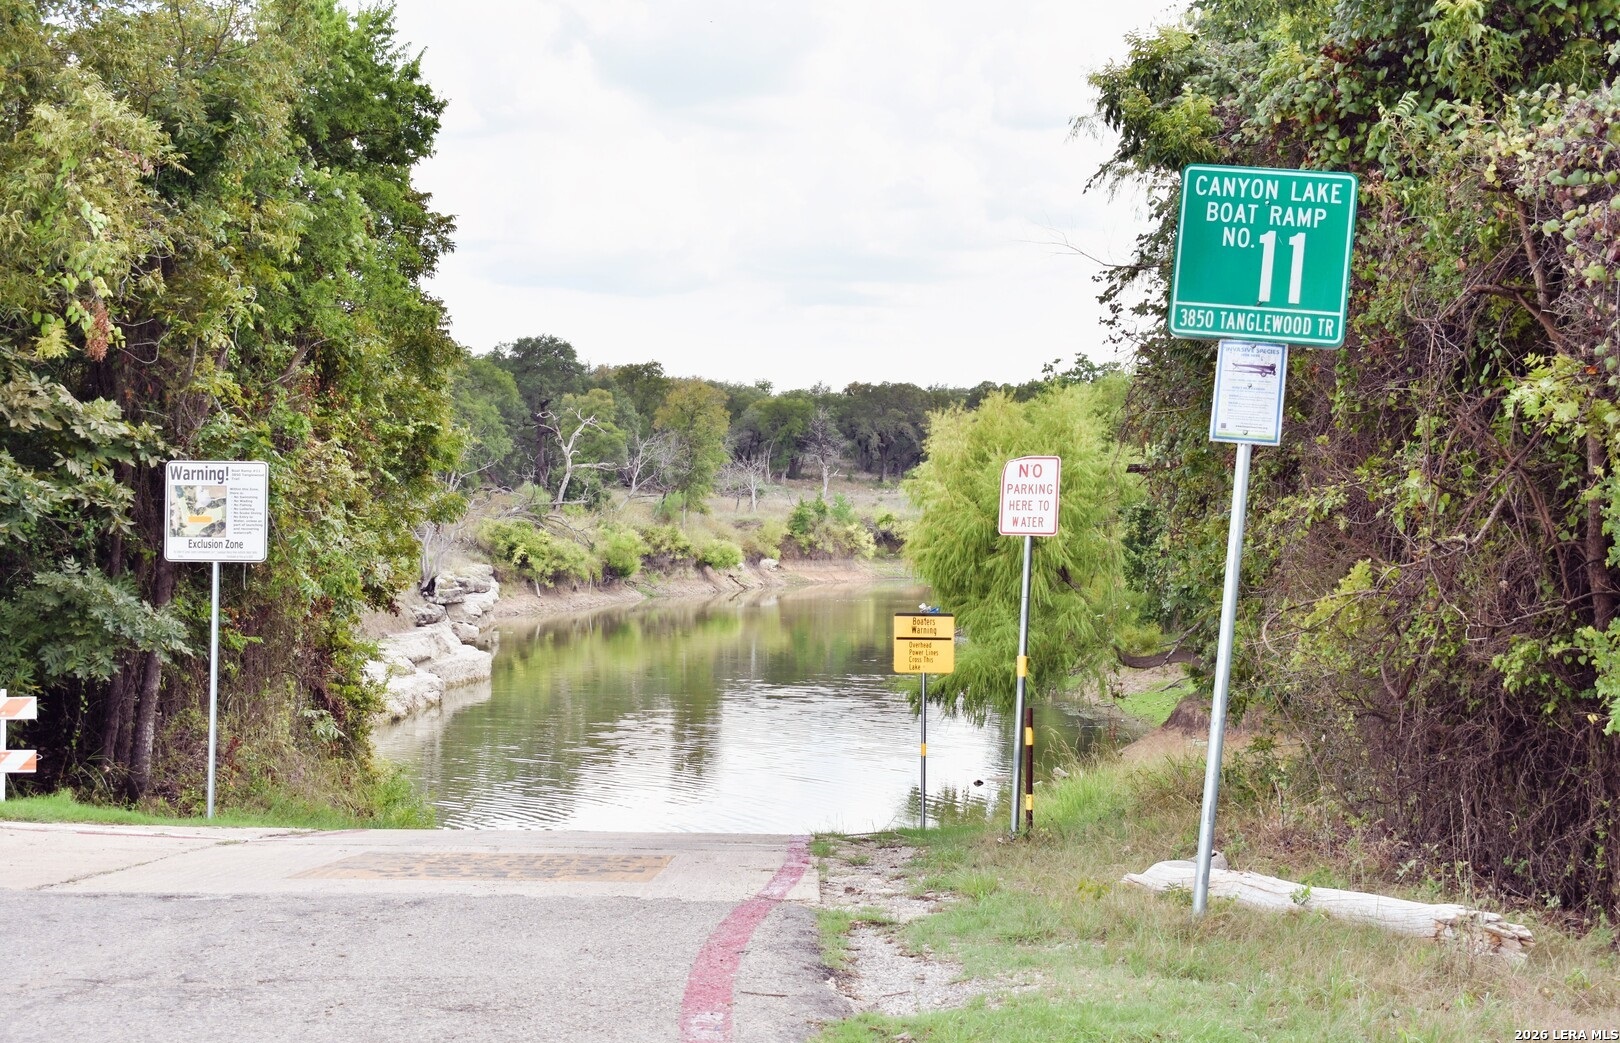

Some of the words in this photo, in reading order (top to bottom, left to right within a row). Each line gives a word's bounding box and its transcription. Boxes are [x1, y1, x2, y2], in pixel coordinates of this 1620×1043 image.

[1195, 175, 1279, 200] CANYON
[1291, 181, 1343, 205] LAKE
[1206, 201, 1259, 224] BOAT
[1269, 205, 1327, 228] RAMP
[1222, 226, 1255, 249] NO.
[1258, 230, 1306, 304] 11
[1179, 308, 1214, 328] 3850
[1220, 311, 1312, 335] TANGLEWOOD
[1318, 318, 1334, 337] TR
[170, 465, 229, 484] Warning!
[1019, 463, 1043, 478] NO
[1007, 484, 1053, 494] PARKING
[1009, 500, 1033, 511] HERE
[1038, 500, 1050, 511] TO
[1012, 517, 1044, 527] WATER
[188, 539, 223, 548] Exclusion
[225, 540, 244, 549] Zone
[912, 617, 936, 626] Boaters
[912, 626, 937, 636] Warning
